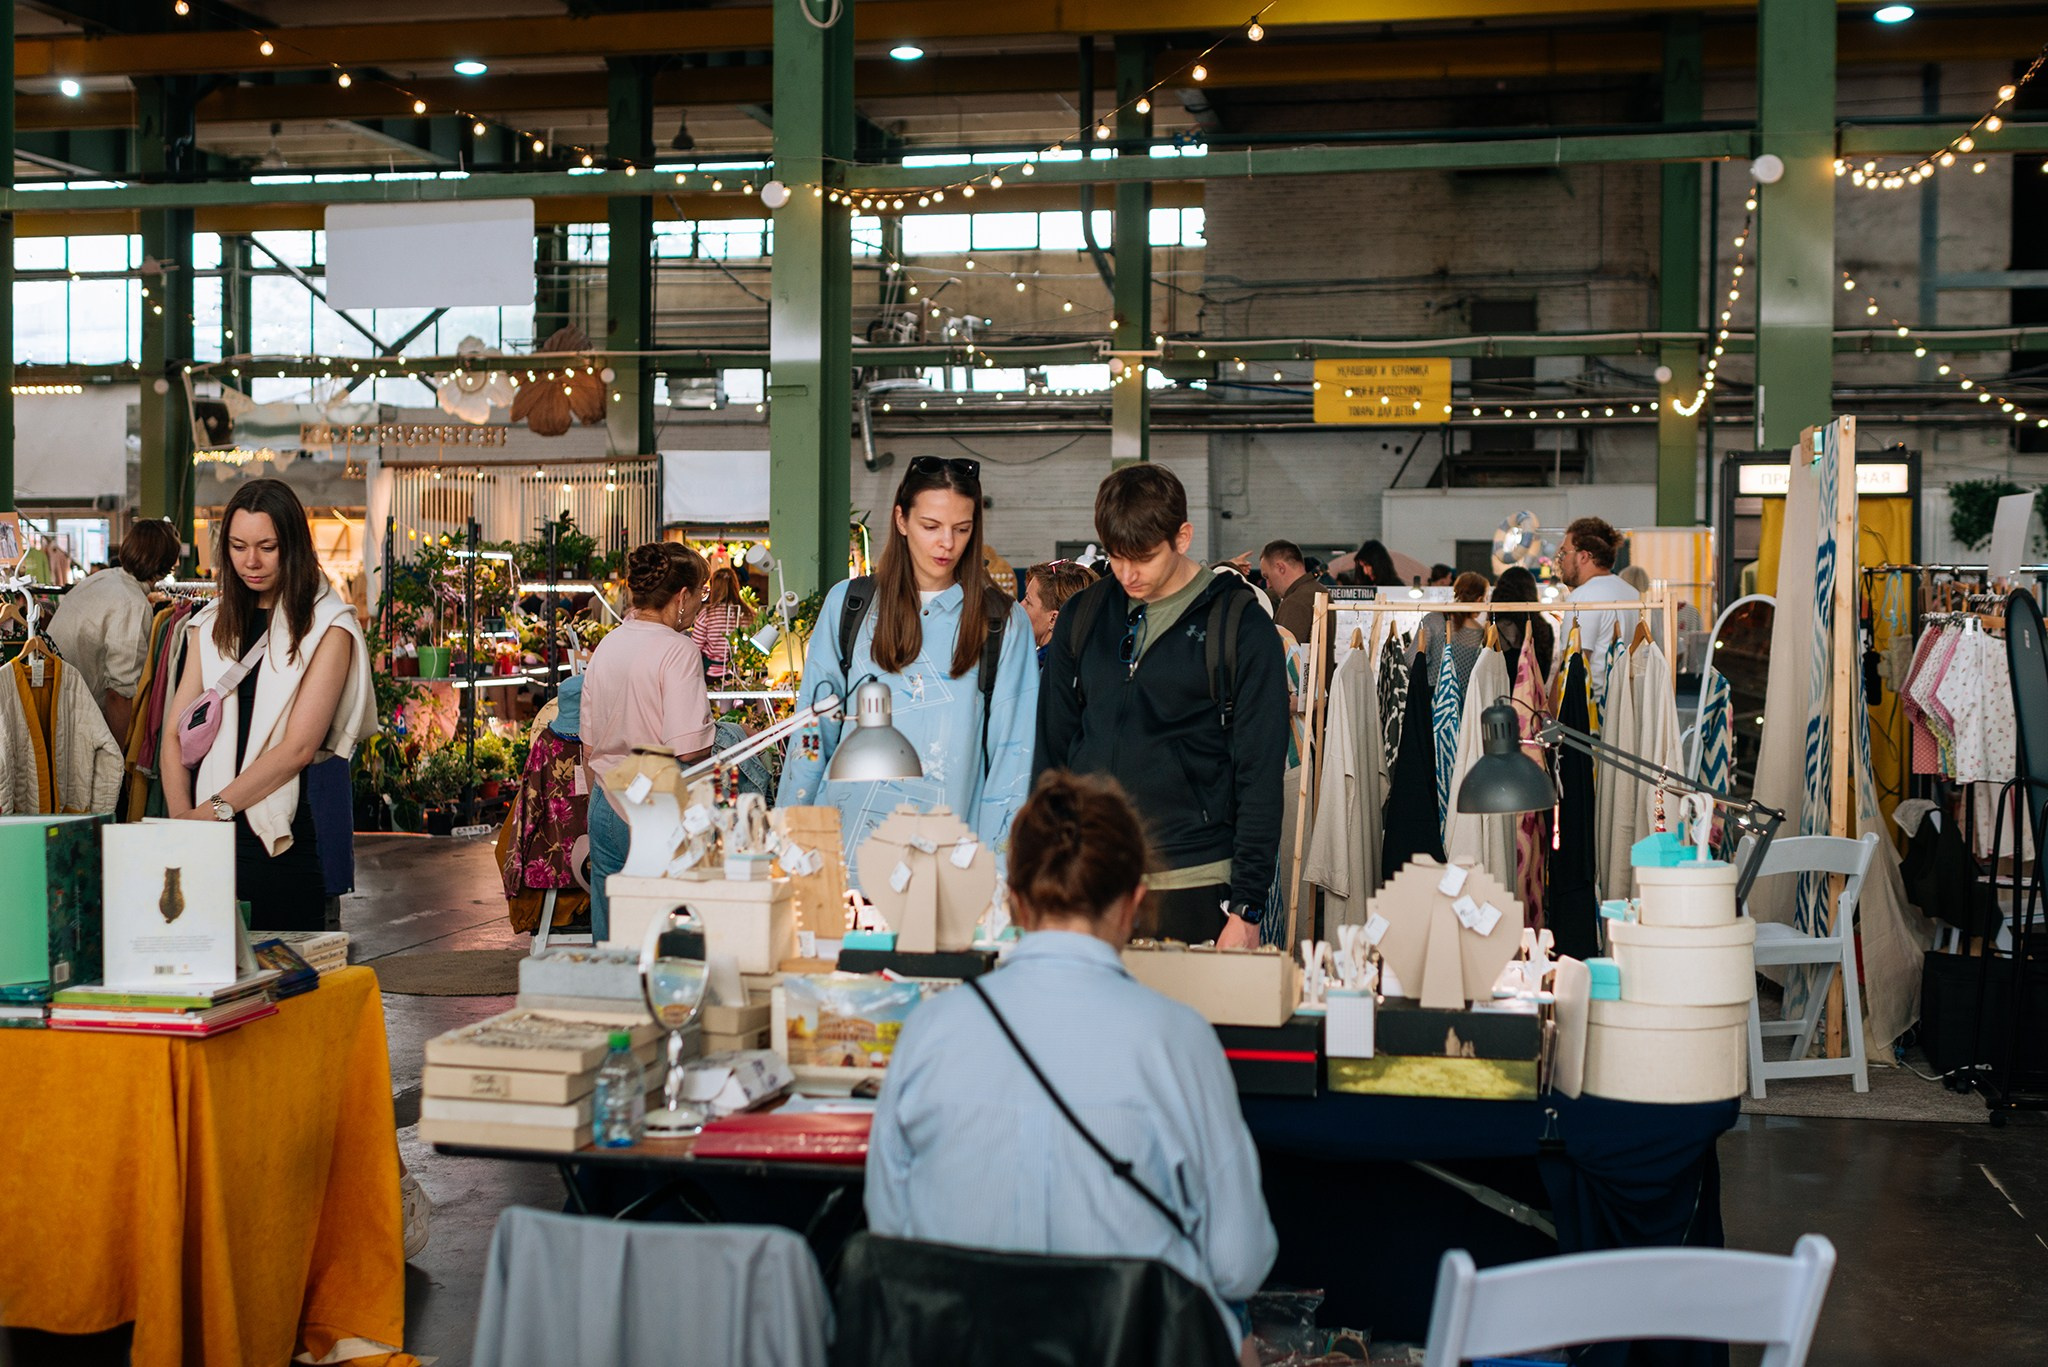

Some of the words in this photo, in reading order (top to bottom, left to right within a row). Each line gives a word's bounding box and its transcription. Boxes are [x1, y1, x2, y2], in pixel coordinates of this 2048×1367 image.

[1337, 365, 1377, 377] УКРАШЕНИЯ
[1391, 365, 1429, 377] КЕРАМИКА
[1348, 405, 1374, 416] ТОВАРЫ
[1378, 406, 1392, 417] ДЛЯ
[1328, 588, 1375, 599] REOMETRIA
